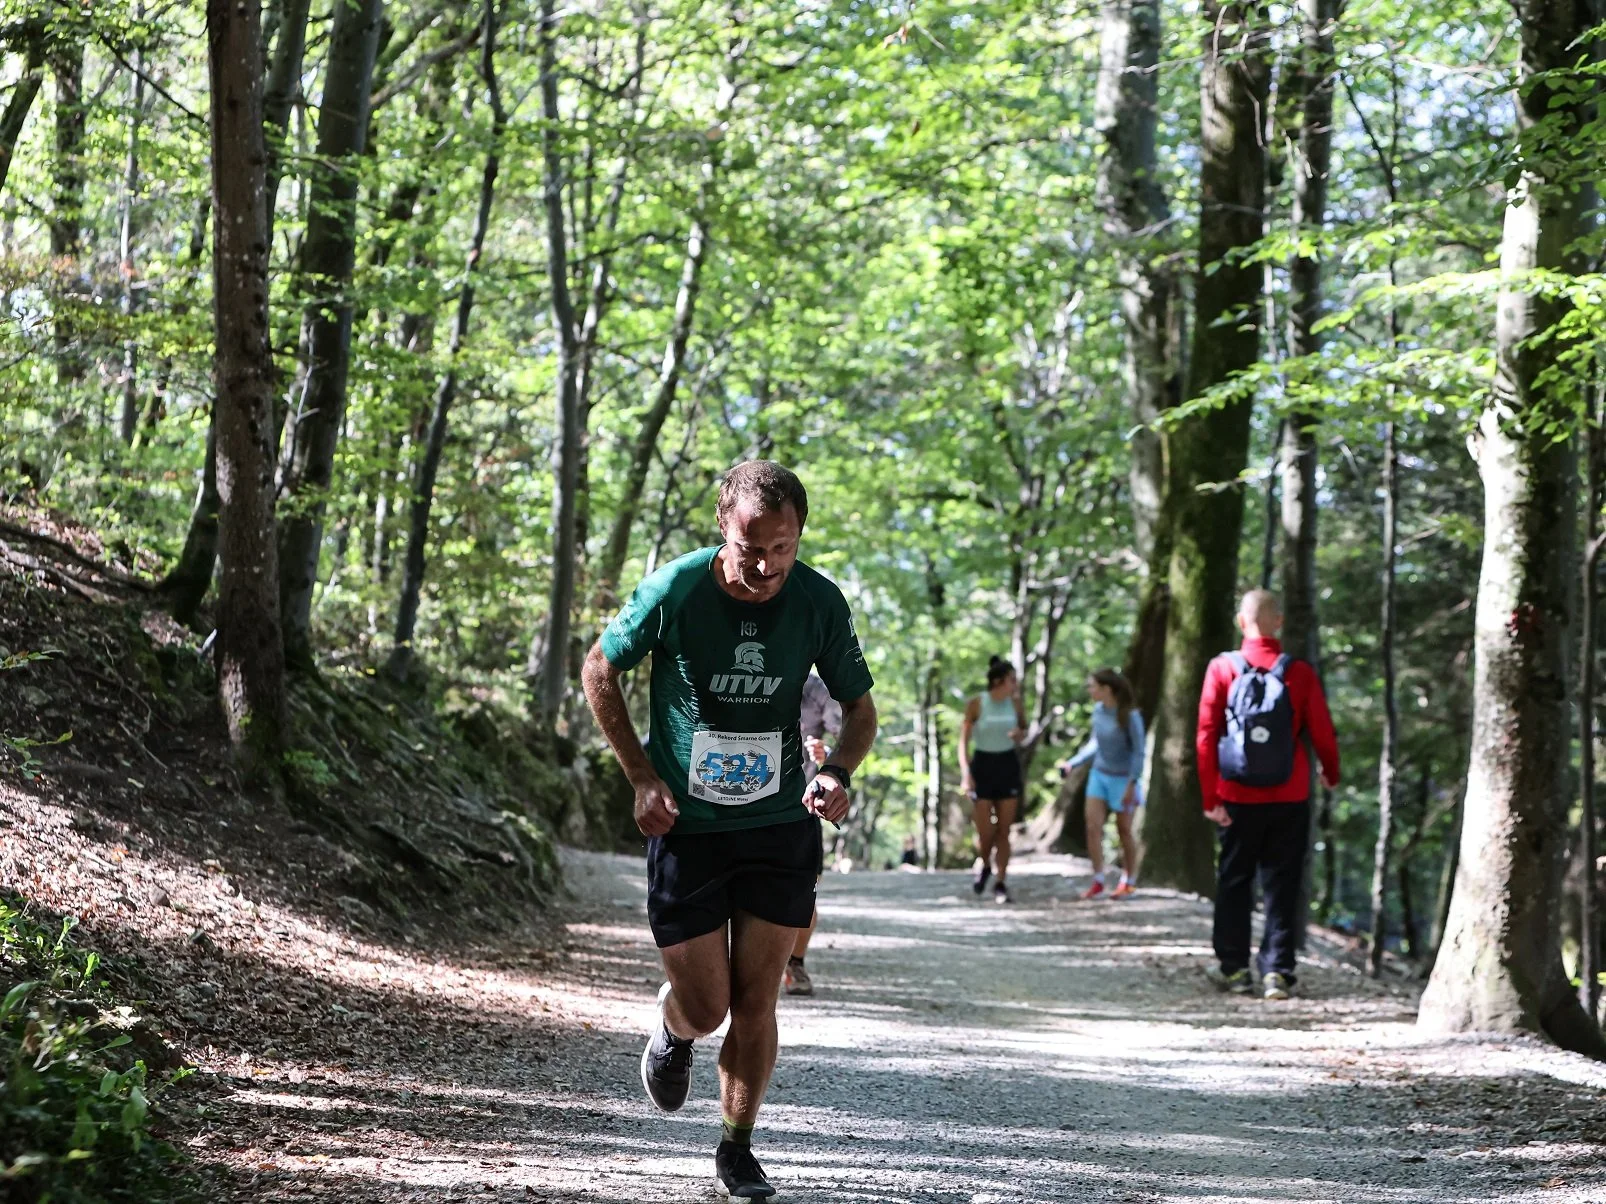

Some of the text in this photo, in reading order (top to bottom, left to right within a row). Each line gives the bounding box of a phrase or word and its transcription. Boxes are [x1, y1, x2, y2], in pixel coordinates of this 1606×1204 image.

[709, 674, 783, 695] UTVV
[717, 696, 770, 704] WARRIOR
[703, 752, 769, 783] 524
